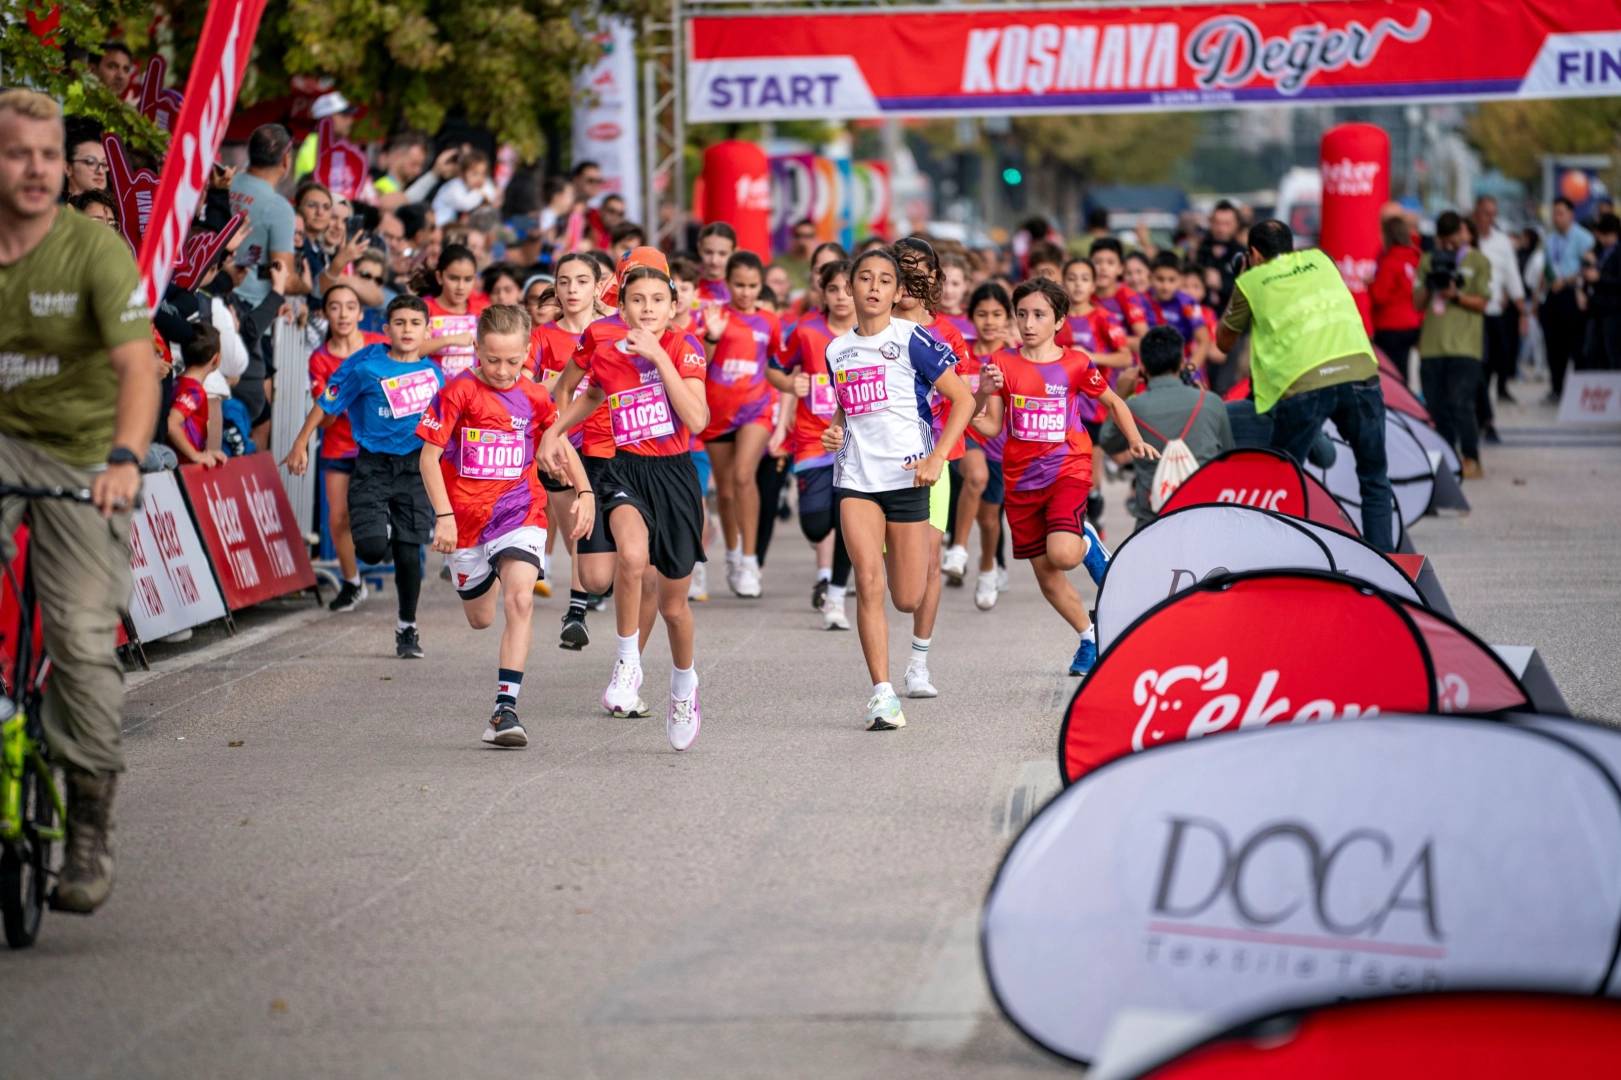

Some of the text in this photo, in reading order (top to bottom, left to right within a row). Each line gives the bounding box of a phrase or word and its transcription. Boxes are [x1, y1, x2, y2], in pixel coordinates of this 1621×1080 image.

[962, 8, 1431, 94] KOŞMAYA Değer
[709, 75, 839, 108] START
[401, 381, 438, 404] 11051
[847, 380, 886, 404] 11018
[620, 402, 668, 430] 11029
[1023, 413, 1064, 430] 11059
[477, 446, 522, 467] 11010
[1149, 813, 1448, 942] DOCA
[1142, 935, 1317, 978] Textile
